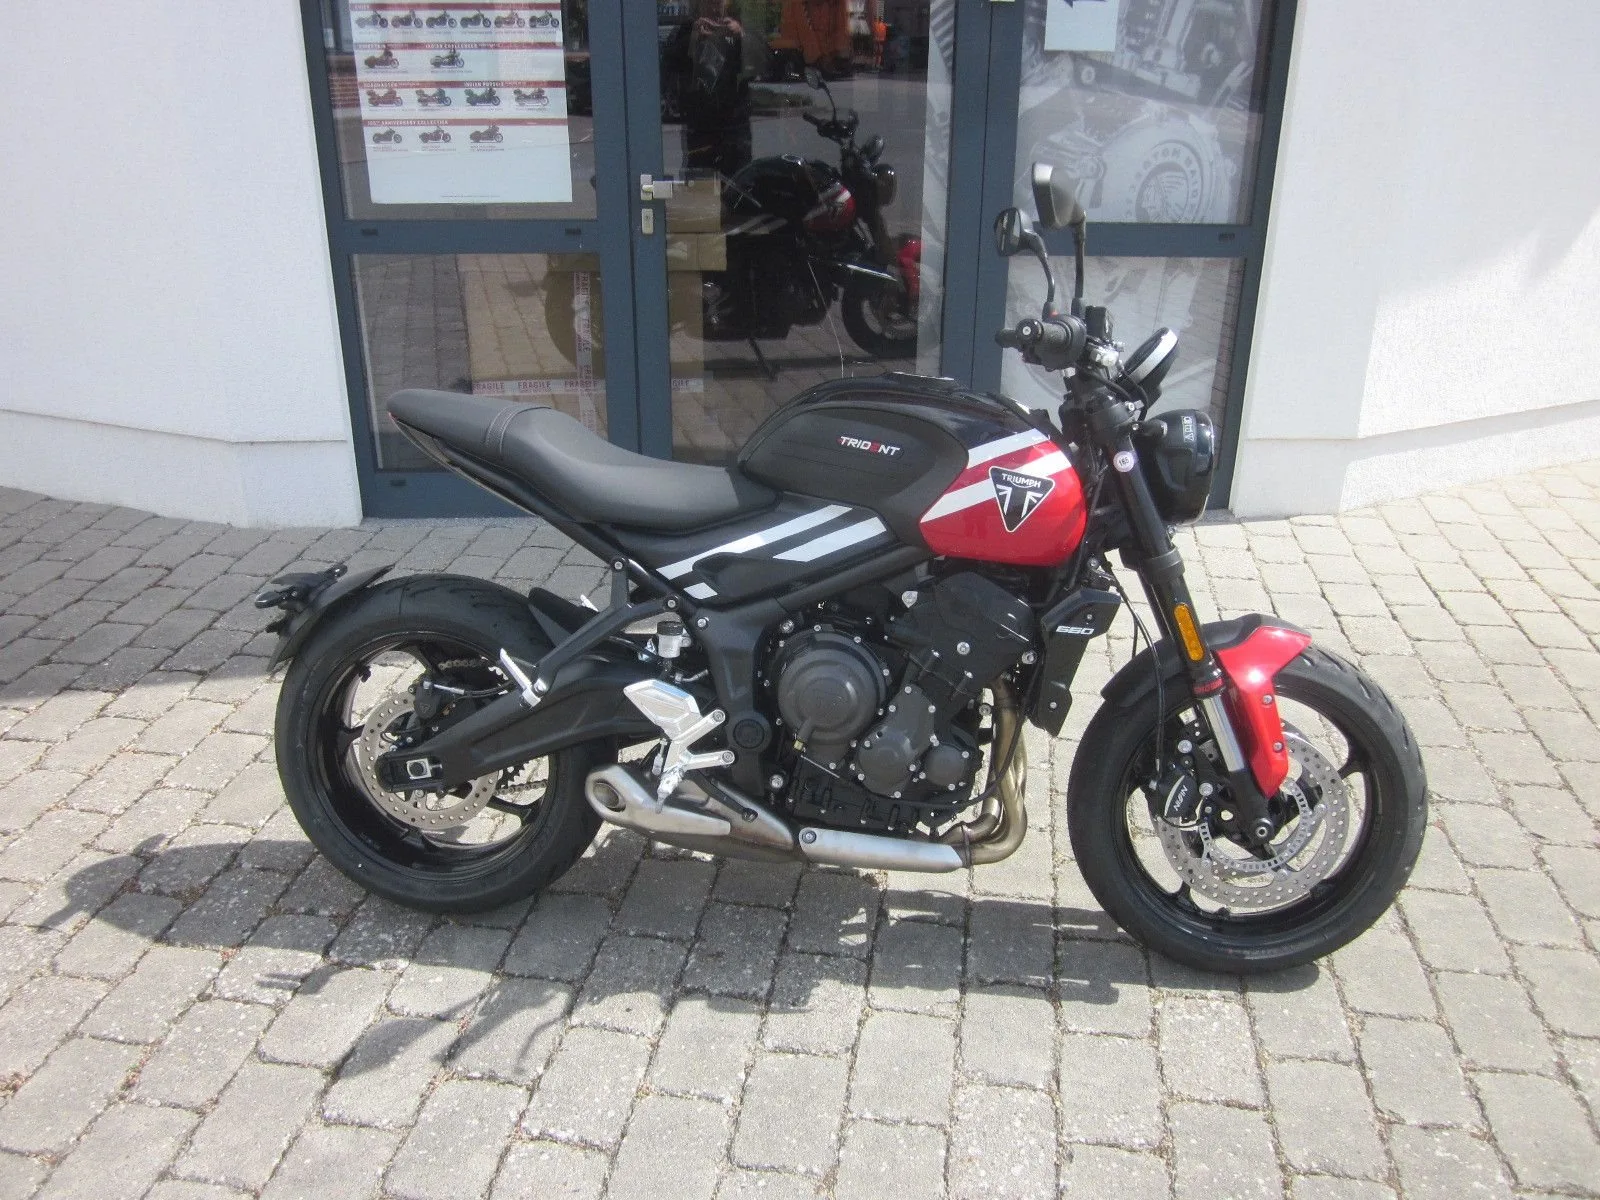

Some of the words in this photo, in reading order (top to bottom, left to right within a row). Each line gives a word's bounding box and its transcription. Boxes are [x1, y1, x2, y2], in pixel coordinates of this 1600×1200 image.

[518, 381, 551, 389] FRAGILE
[840, 436, 901, 456] TRIDENT
[1001, 473, 1042, 488] TRIUMPH
[1056, 625, 1094, 635] 660
